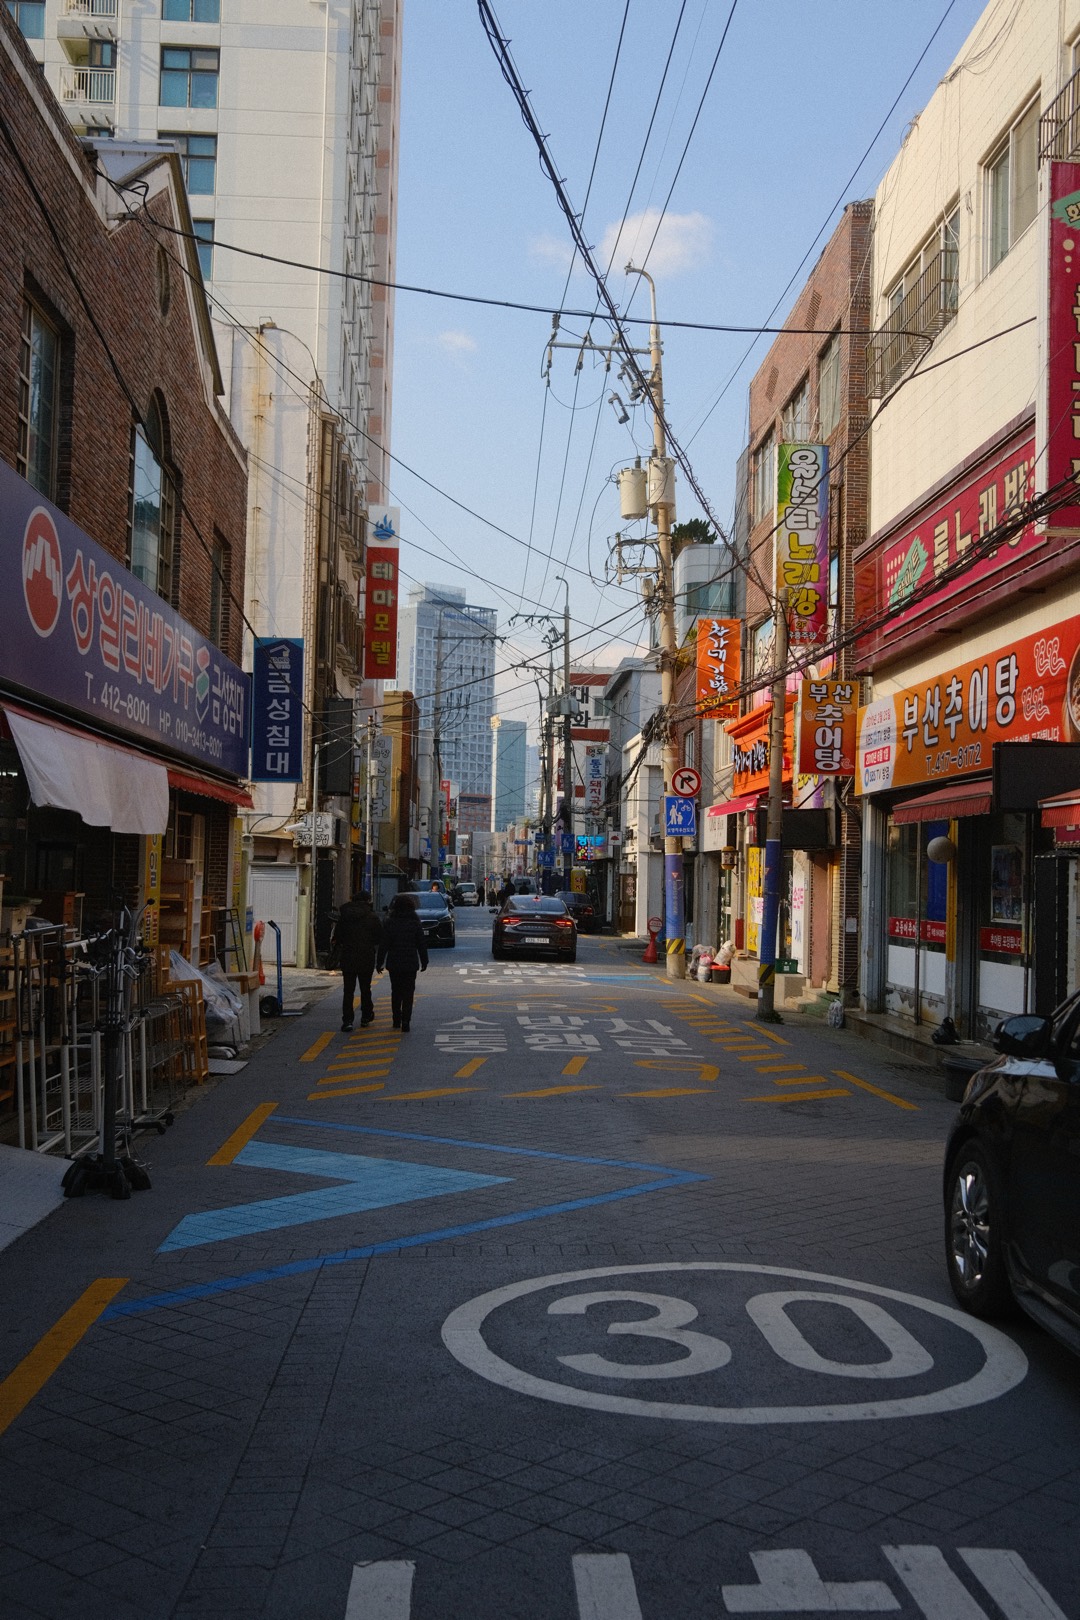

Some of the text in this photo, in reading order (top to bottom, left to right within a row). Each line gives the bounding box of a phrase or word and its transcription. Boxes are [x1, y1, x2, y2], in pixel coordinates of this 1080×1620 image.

[783, 532, 821, 616] 노래방
[65, 548, 194, 711] 상일리베가구
[101, 682, 150, 727] 412-8001
[211, 664, 245, 739] 금성침대
[265, 672, 292, 774] 금성침대
[809, 683, 853, 704] 부산
[901, 652, 1019, 753] 부산추어탕
[814, 704, 844, 771] 추어탕
[925, 742, 981, 776] T.417-8172
[546, 1290, 935, 1380] 30
